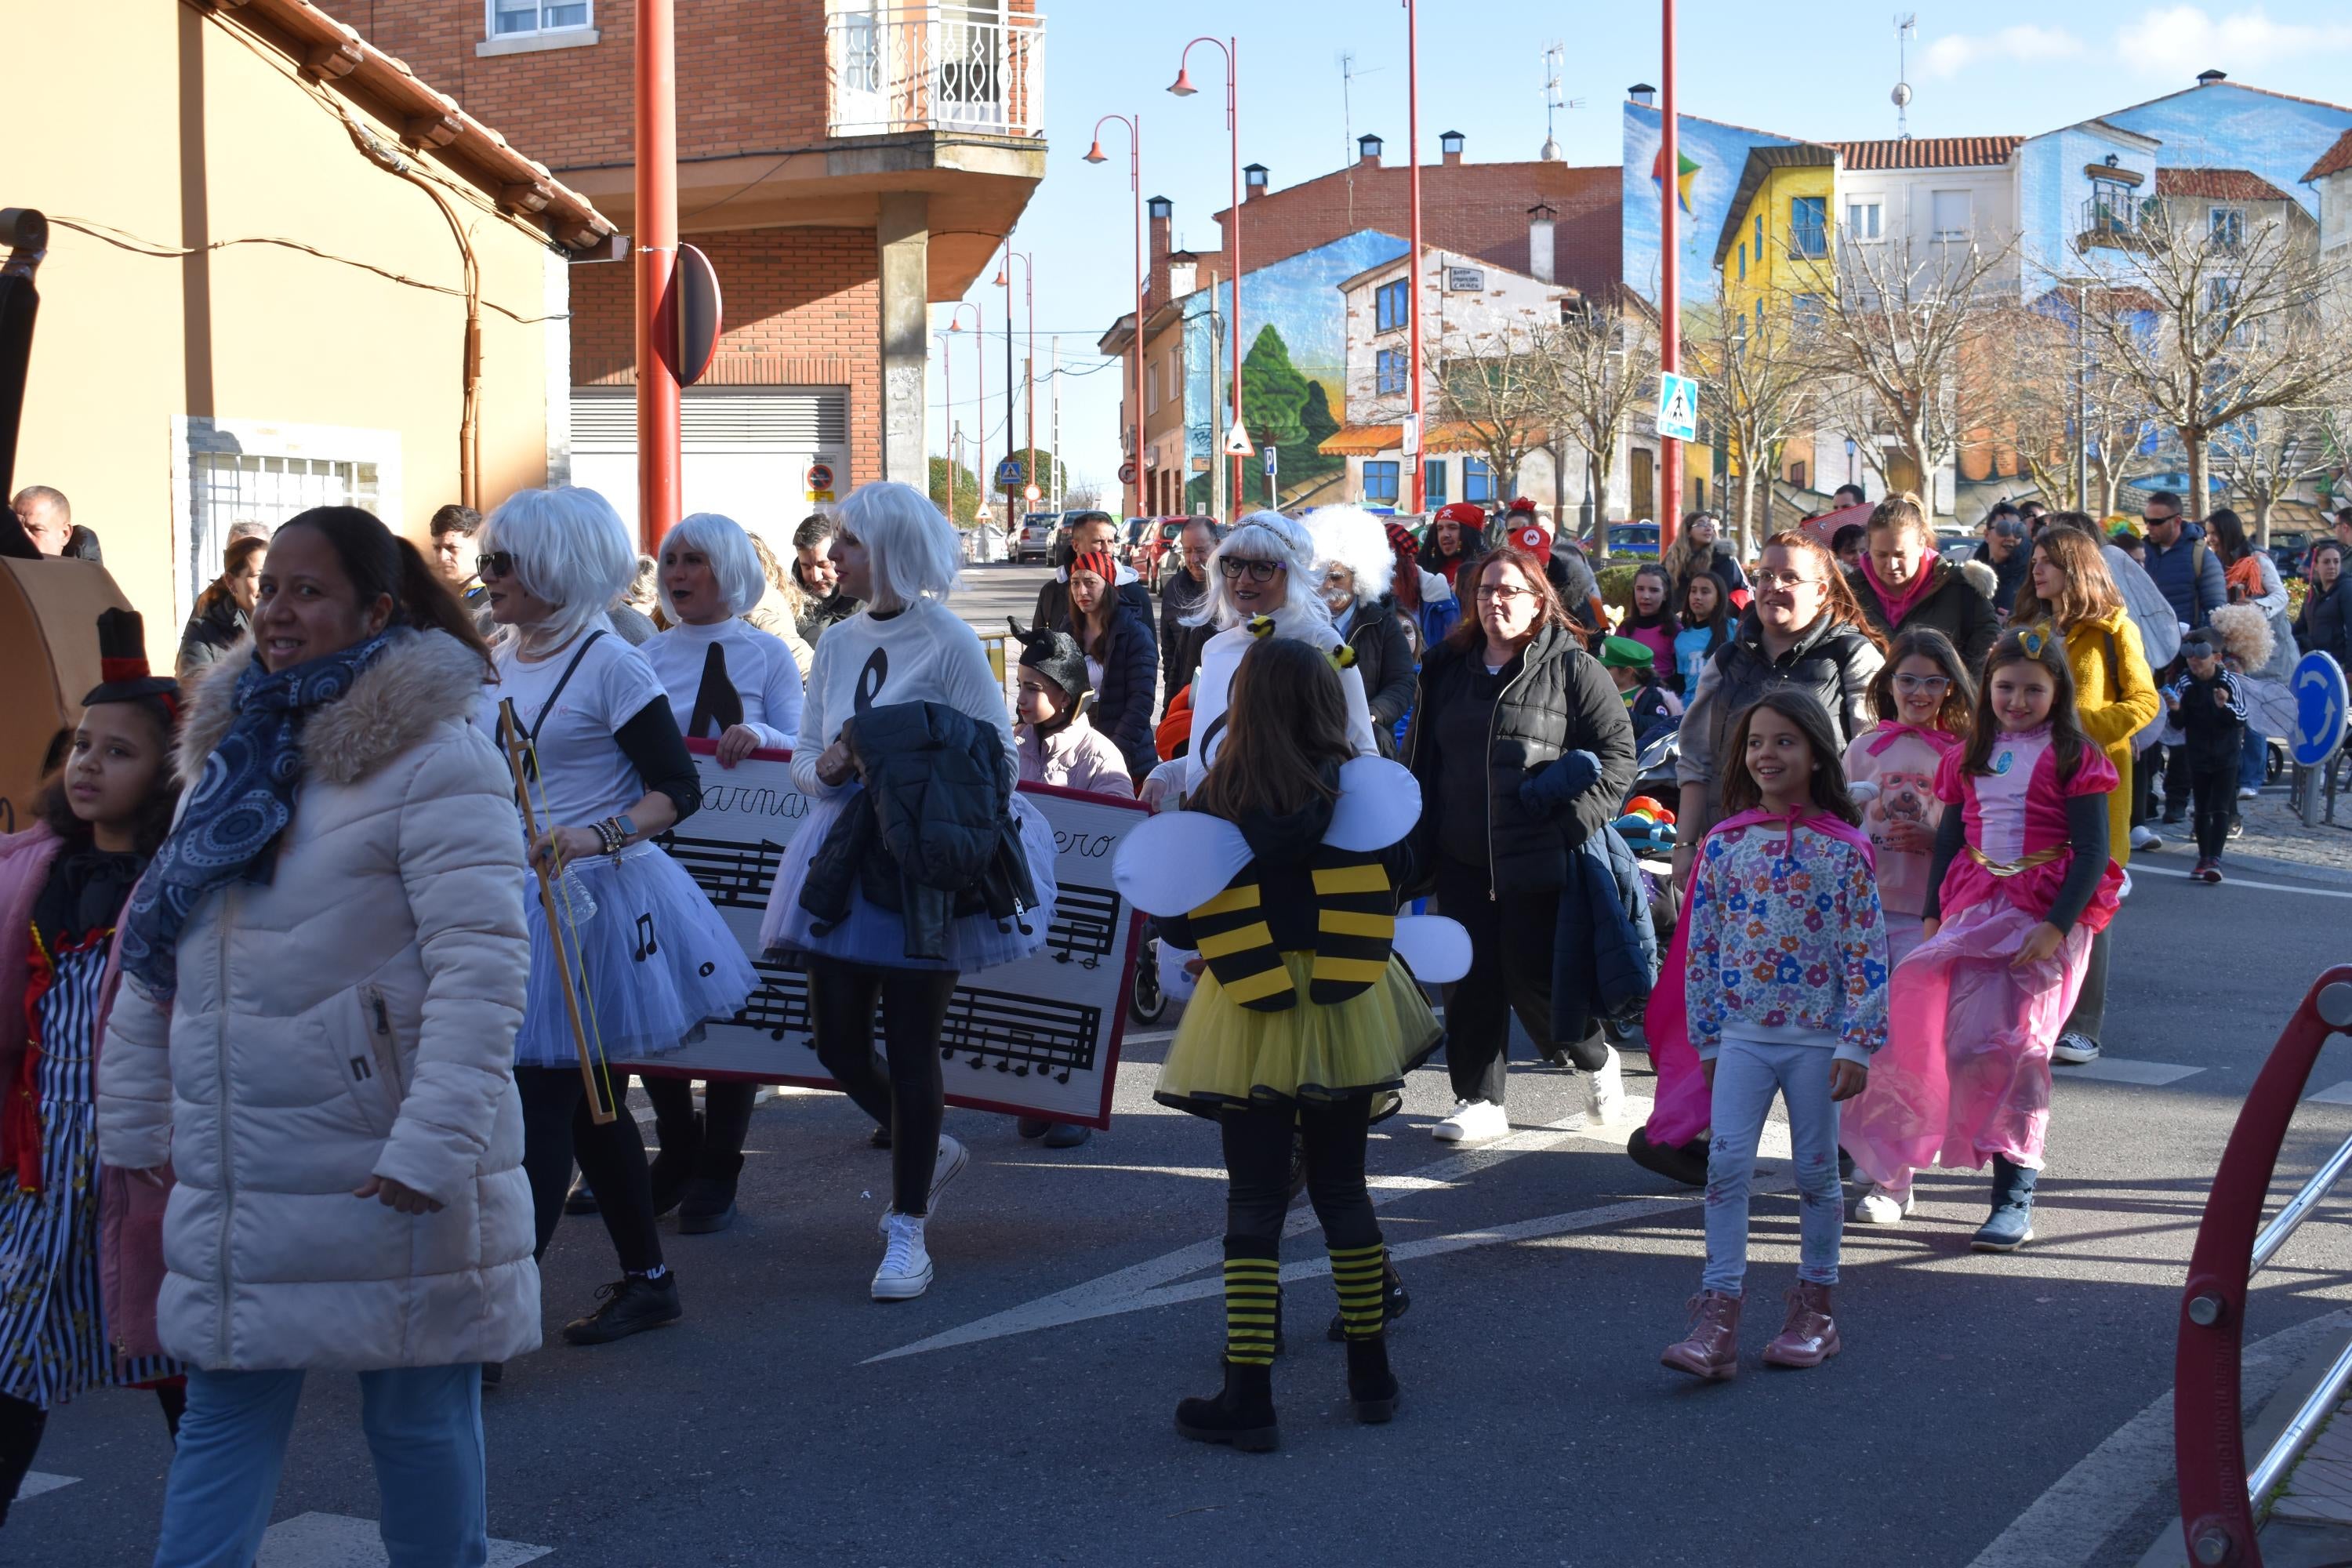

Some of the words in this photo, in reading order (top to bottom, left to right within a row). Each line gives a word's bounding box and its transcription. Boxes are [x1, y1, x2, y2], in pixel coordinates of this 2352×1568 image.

[1266, 450, 1273, 473] P
[1526, 533, 1538, 542] M
[696, 775, 811, 820] arna
